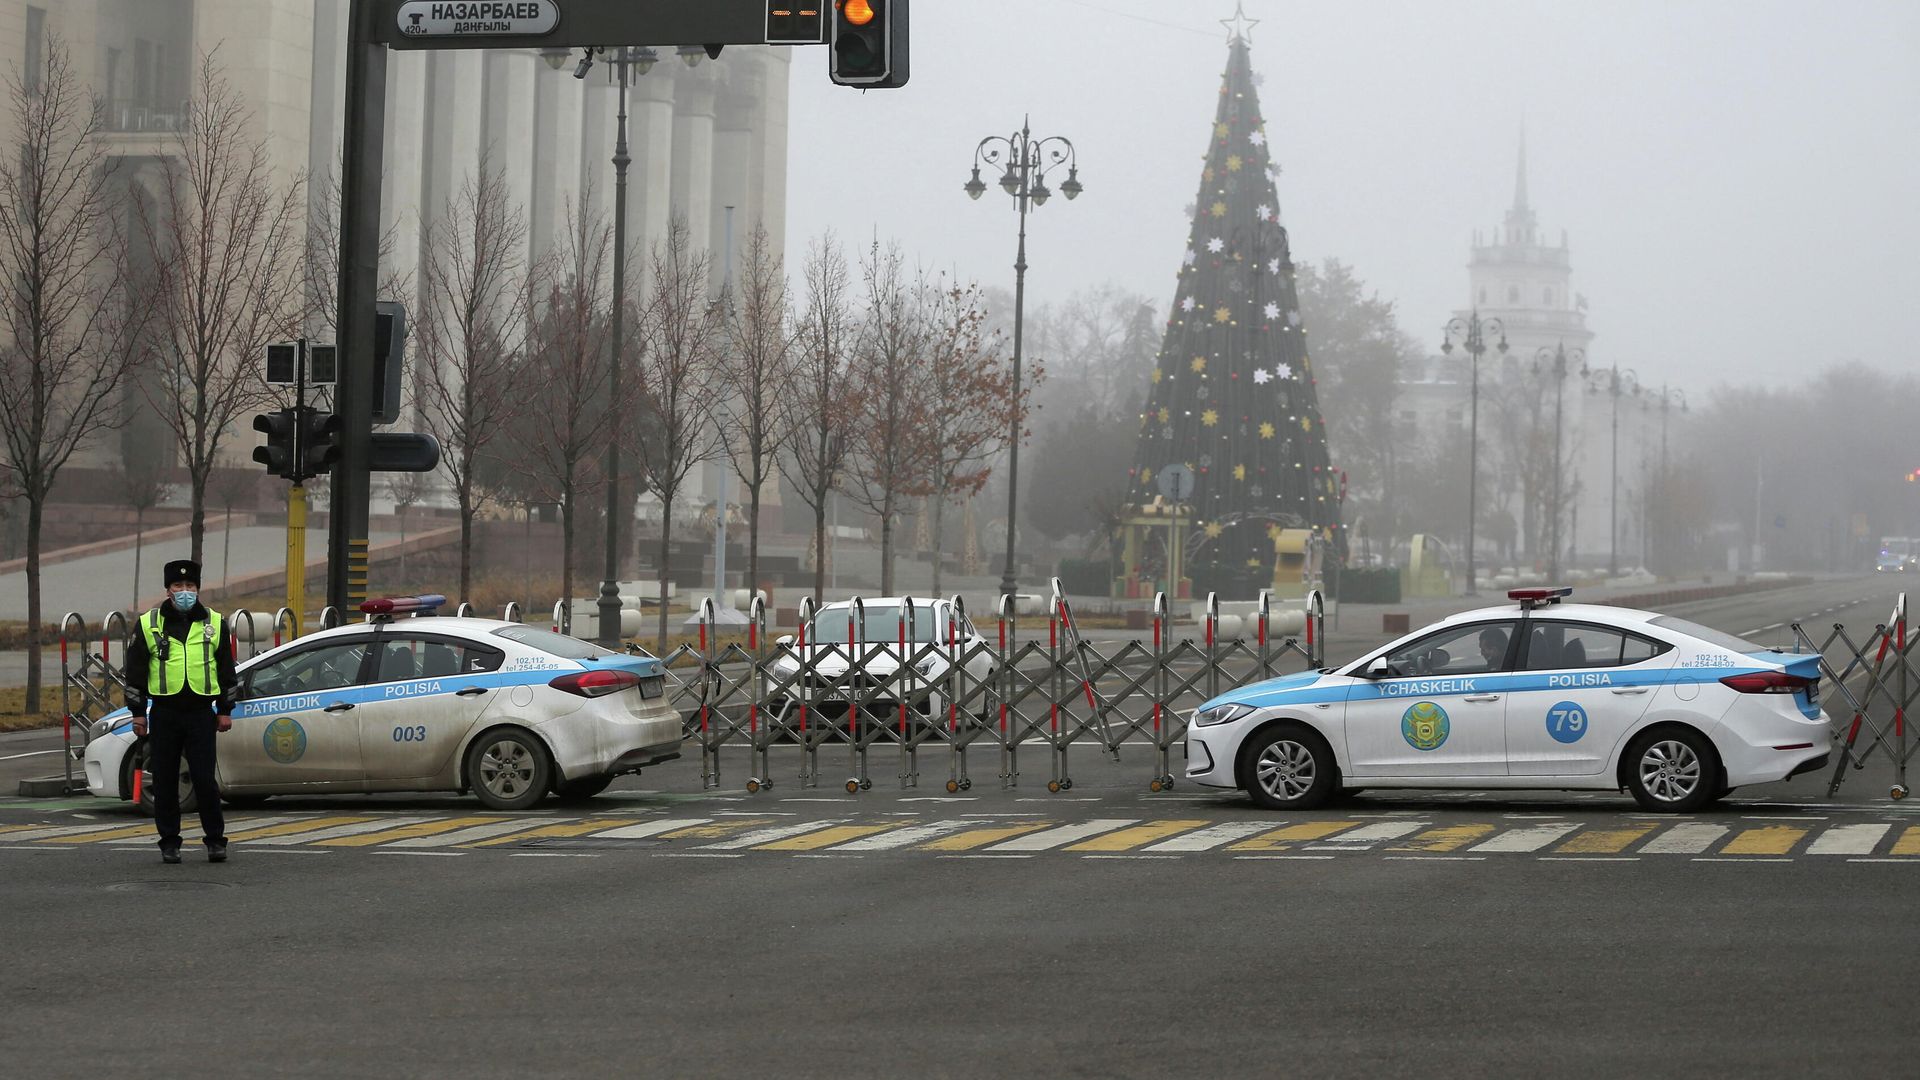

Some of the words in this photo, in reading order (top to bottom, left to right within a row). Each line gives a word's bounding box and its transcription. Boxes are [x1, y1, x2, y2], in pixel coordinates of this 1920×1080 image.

[431, 3, 539, 20] НАЗАРБАЕВ
[453, 21, 511, 33] даңғылы
[1549, 673, 1612, 687] POLISIA
[385, 681, 442, 697] POLISIA
[1552, 709, 1583, 732] 79
[392, 725, 426, 742] 003
